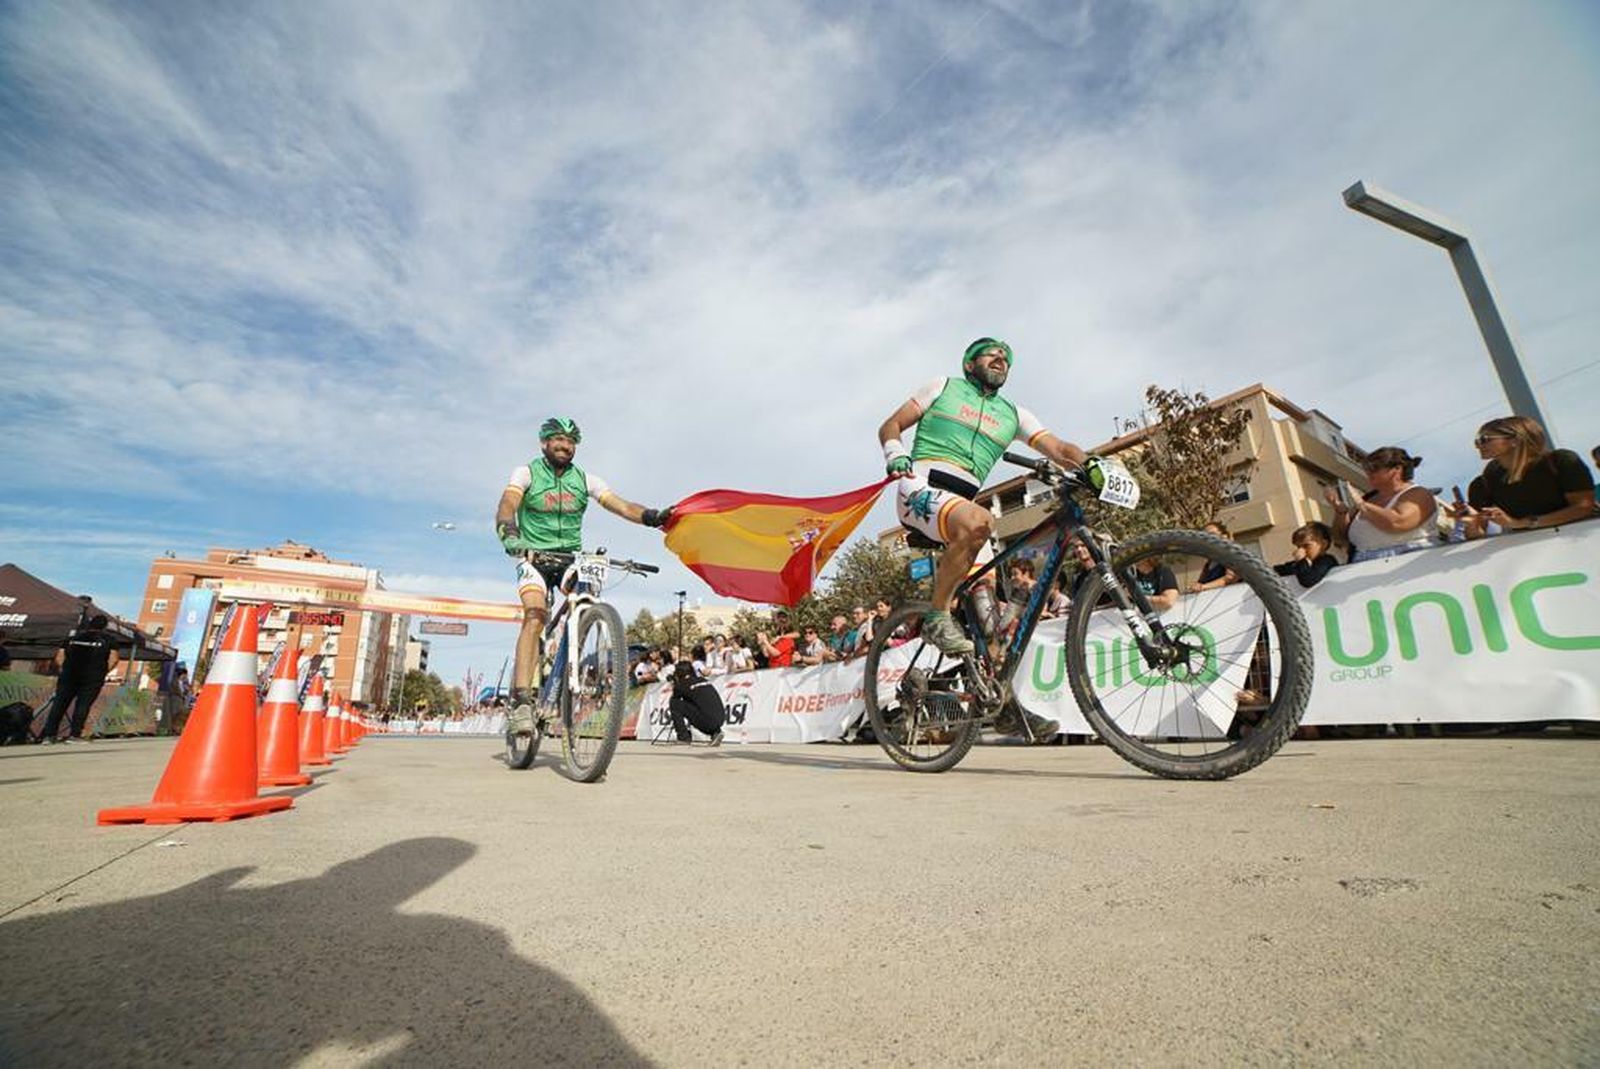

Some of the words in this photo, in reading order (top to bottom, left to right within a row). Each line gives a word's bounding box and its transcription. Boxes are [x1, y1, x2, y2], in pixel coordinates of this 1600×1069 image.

[1108, 474, 1134, 496] 6817
[580, 564, 605, 578] 6821
[1329, 664, 1393, 682] GROUP
[723, 702, 748, 726] ASI
